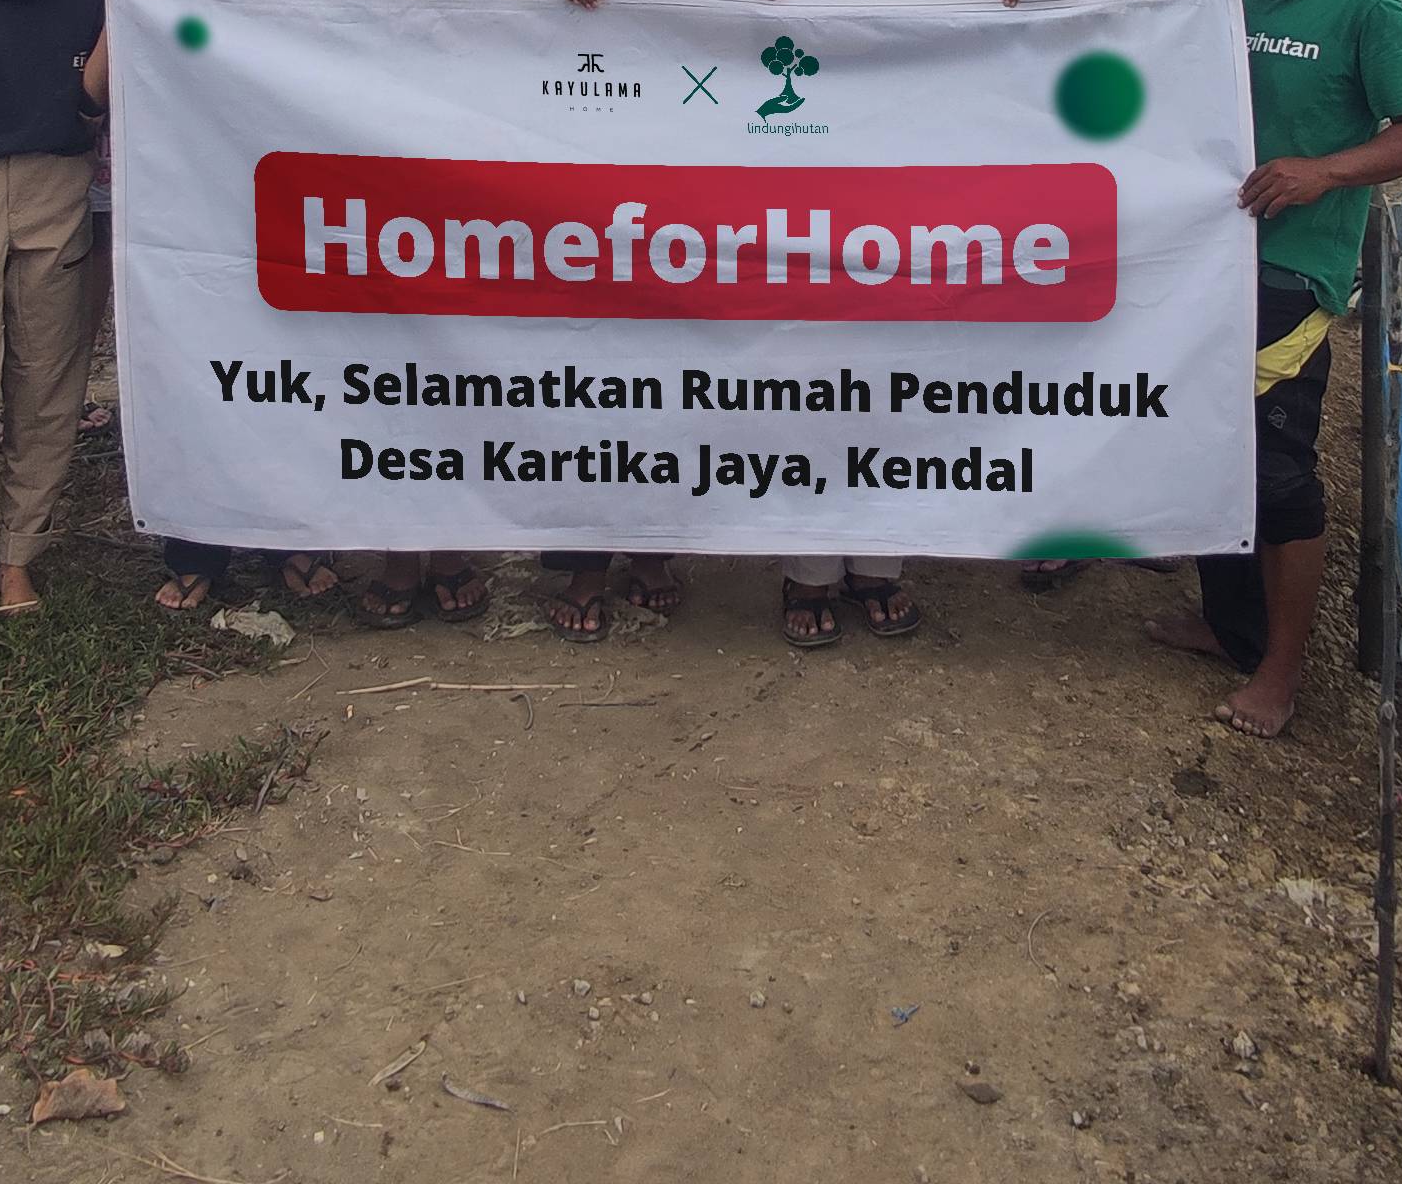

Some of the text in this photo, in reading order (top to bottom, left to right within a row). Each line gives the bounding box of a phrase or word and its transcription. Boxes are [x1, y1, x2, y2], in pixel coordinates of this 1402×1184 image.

[542, 80, 641, 98] KAYULAMA
[747, 122, 829, 137] lindungihutan
[303, 196, 1070, 286] HomeforHome
[210, 359, 1170, 418] Yuk, Selamatkan Rumah Penduduk
[340, 438, 1033, 499] Desa Kartika Jaya, Kendal
